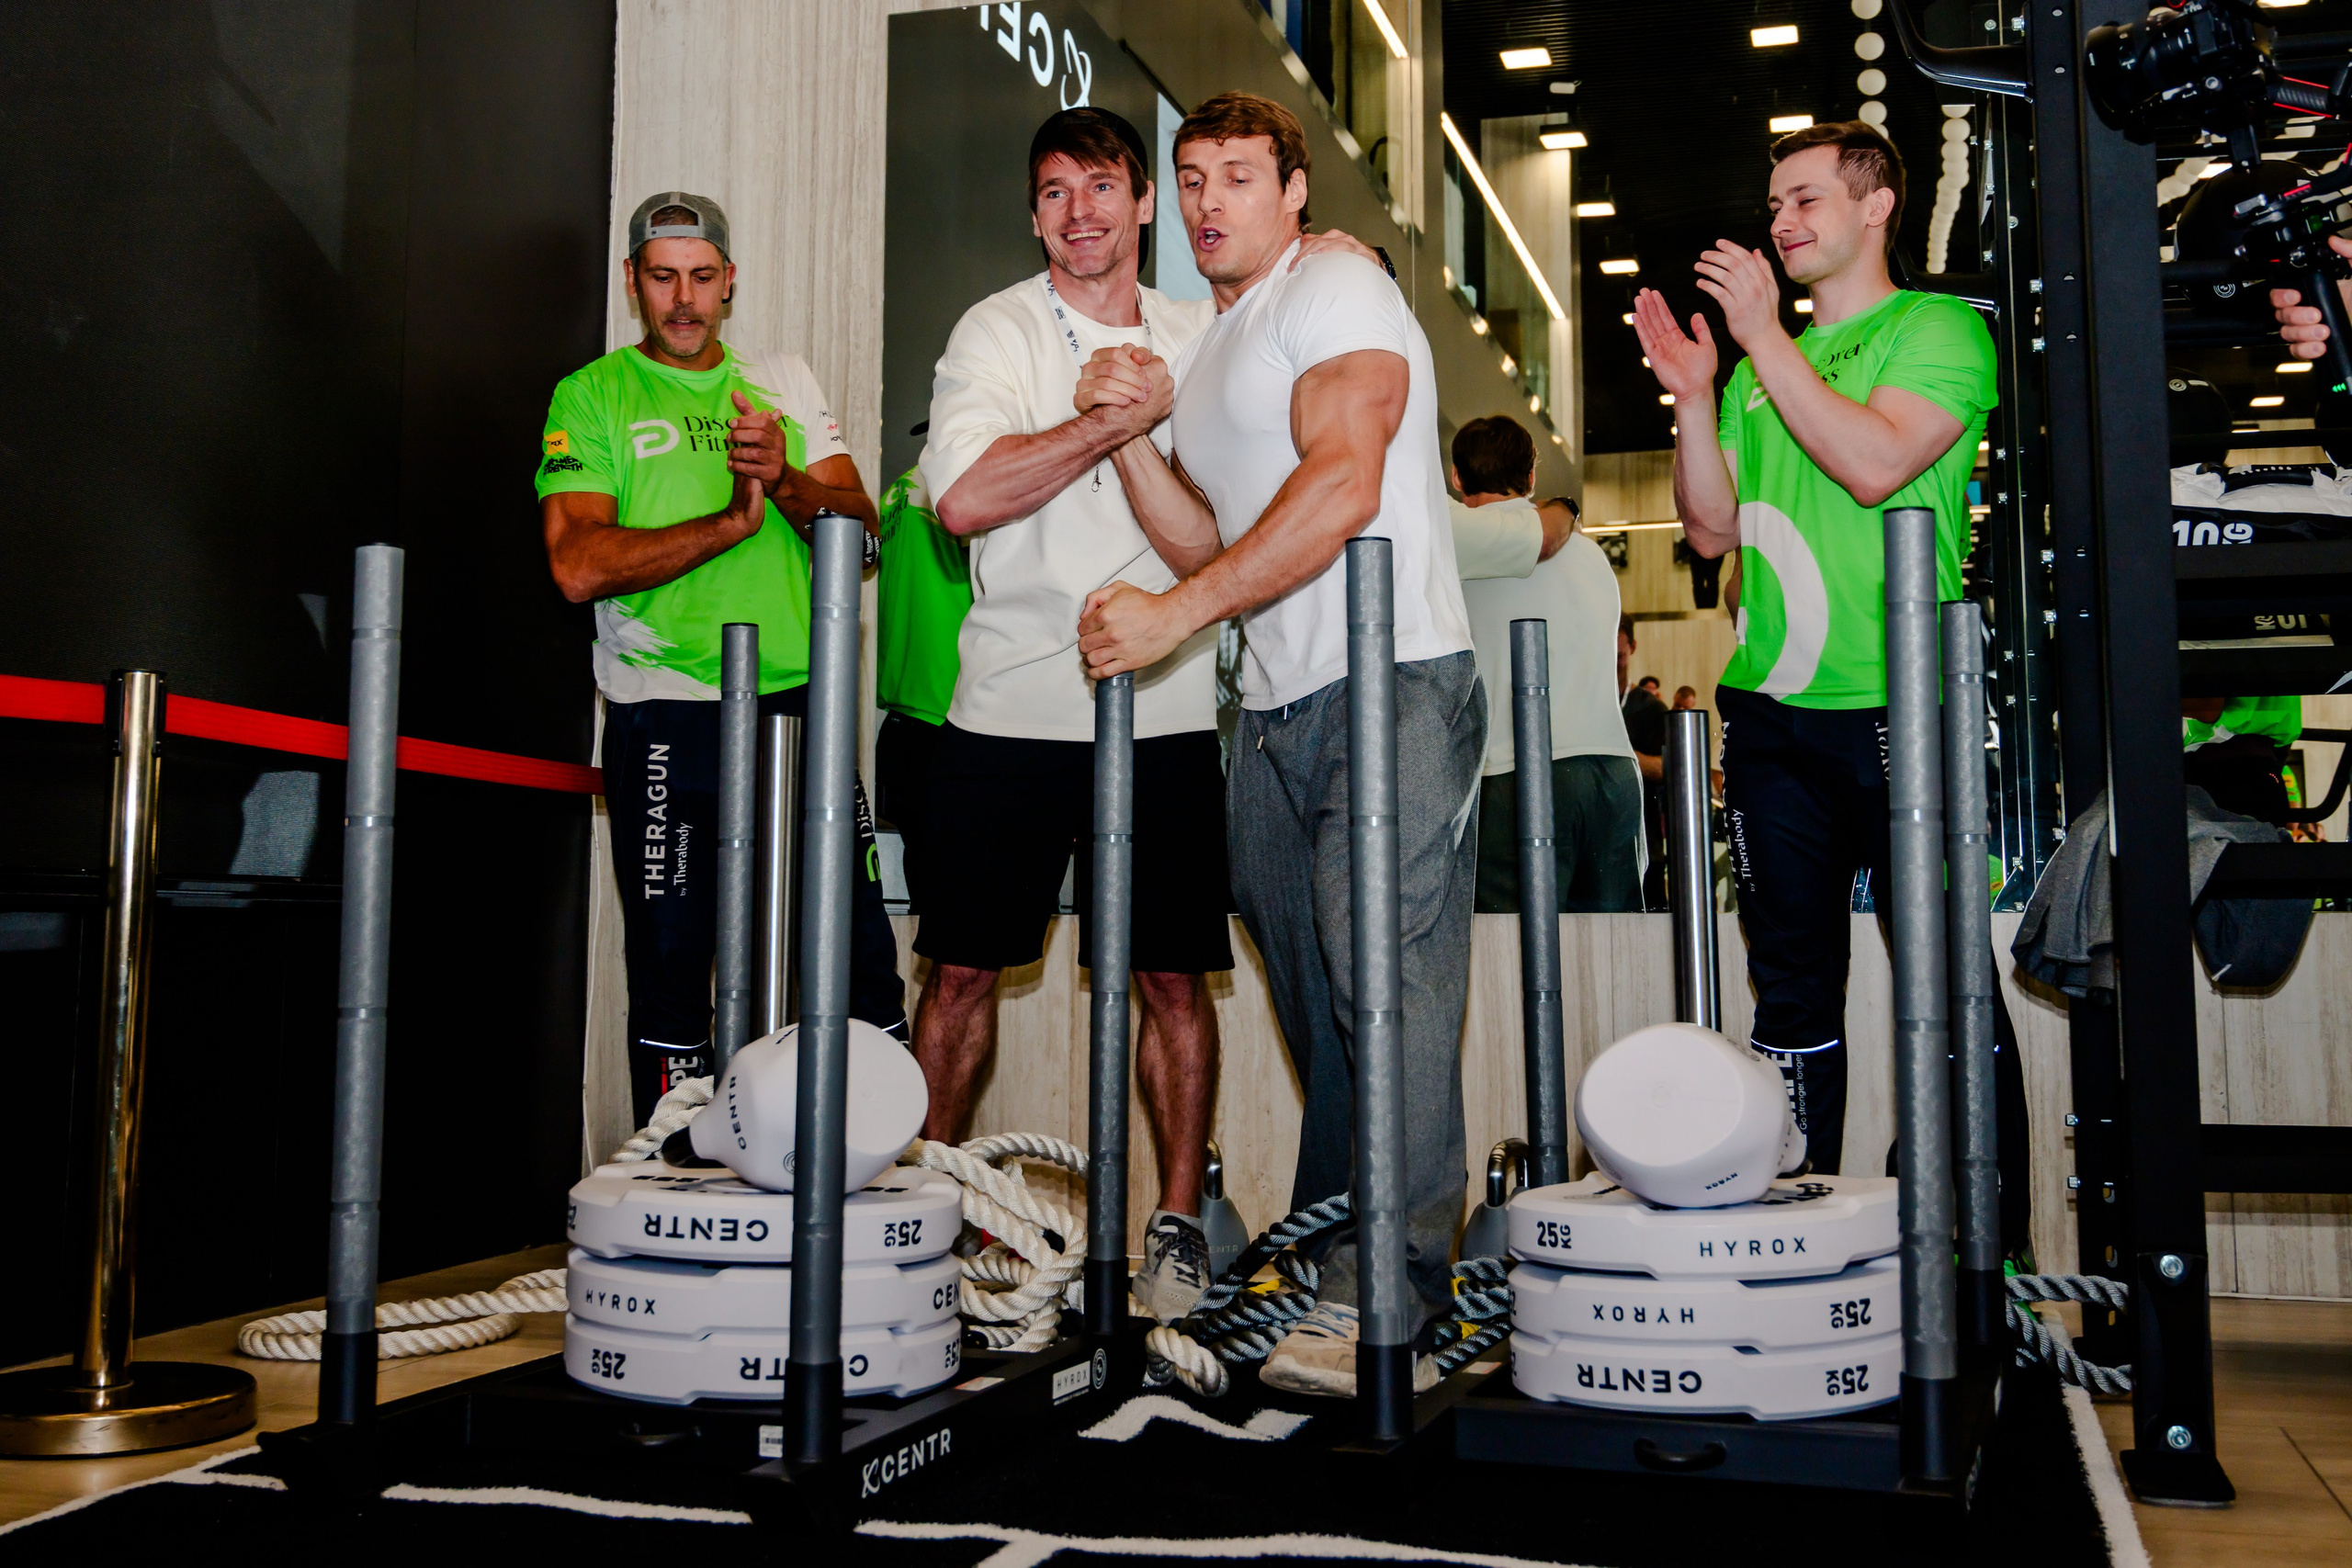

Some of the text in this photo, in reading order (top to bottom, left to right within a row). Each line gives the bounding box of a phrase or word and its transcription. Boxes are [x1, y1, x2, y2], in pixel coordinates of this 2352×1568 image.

[645, 742, 671, 899] THERAGUN
[673, 822, 693, 886] Therabody
[1731, 808, 1752, 879] Therabody
[1795, 1054, 1804, 1080] longer
[1799, 1118, 1807, 1131] Go
[644, 1213, 769, 1242] CENTR
[1699, 1236, 1806, 1258] HYROX
[585, 1288, 656, 1315] HYROX
[1592, 1304, 1694, 1324] HYROX
[740, 1354, 869, 1381] CTR
[1577, 1363, 1702, 1393] CENTR
[880, 1427, 952, 1483] CENTR
